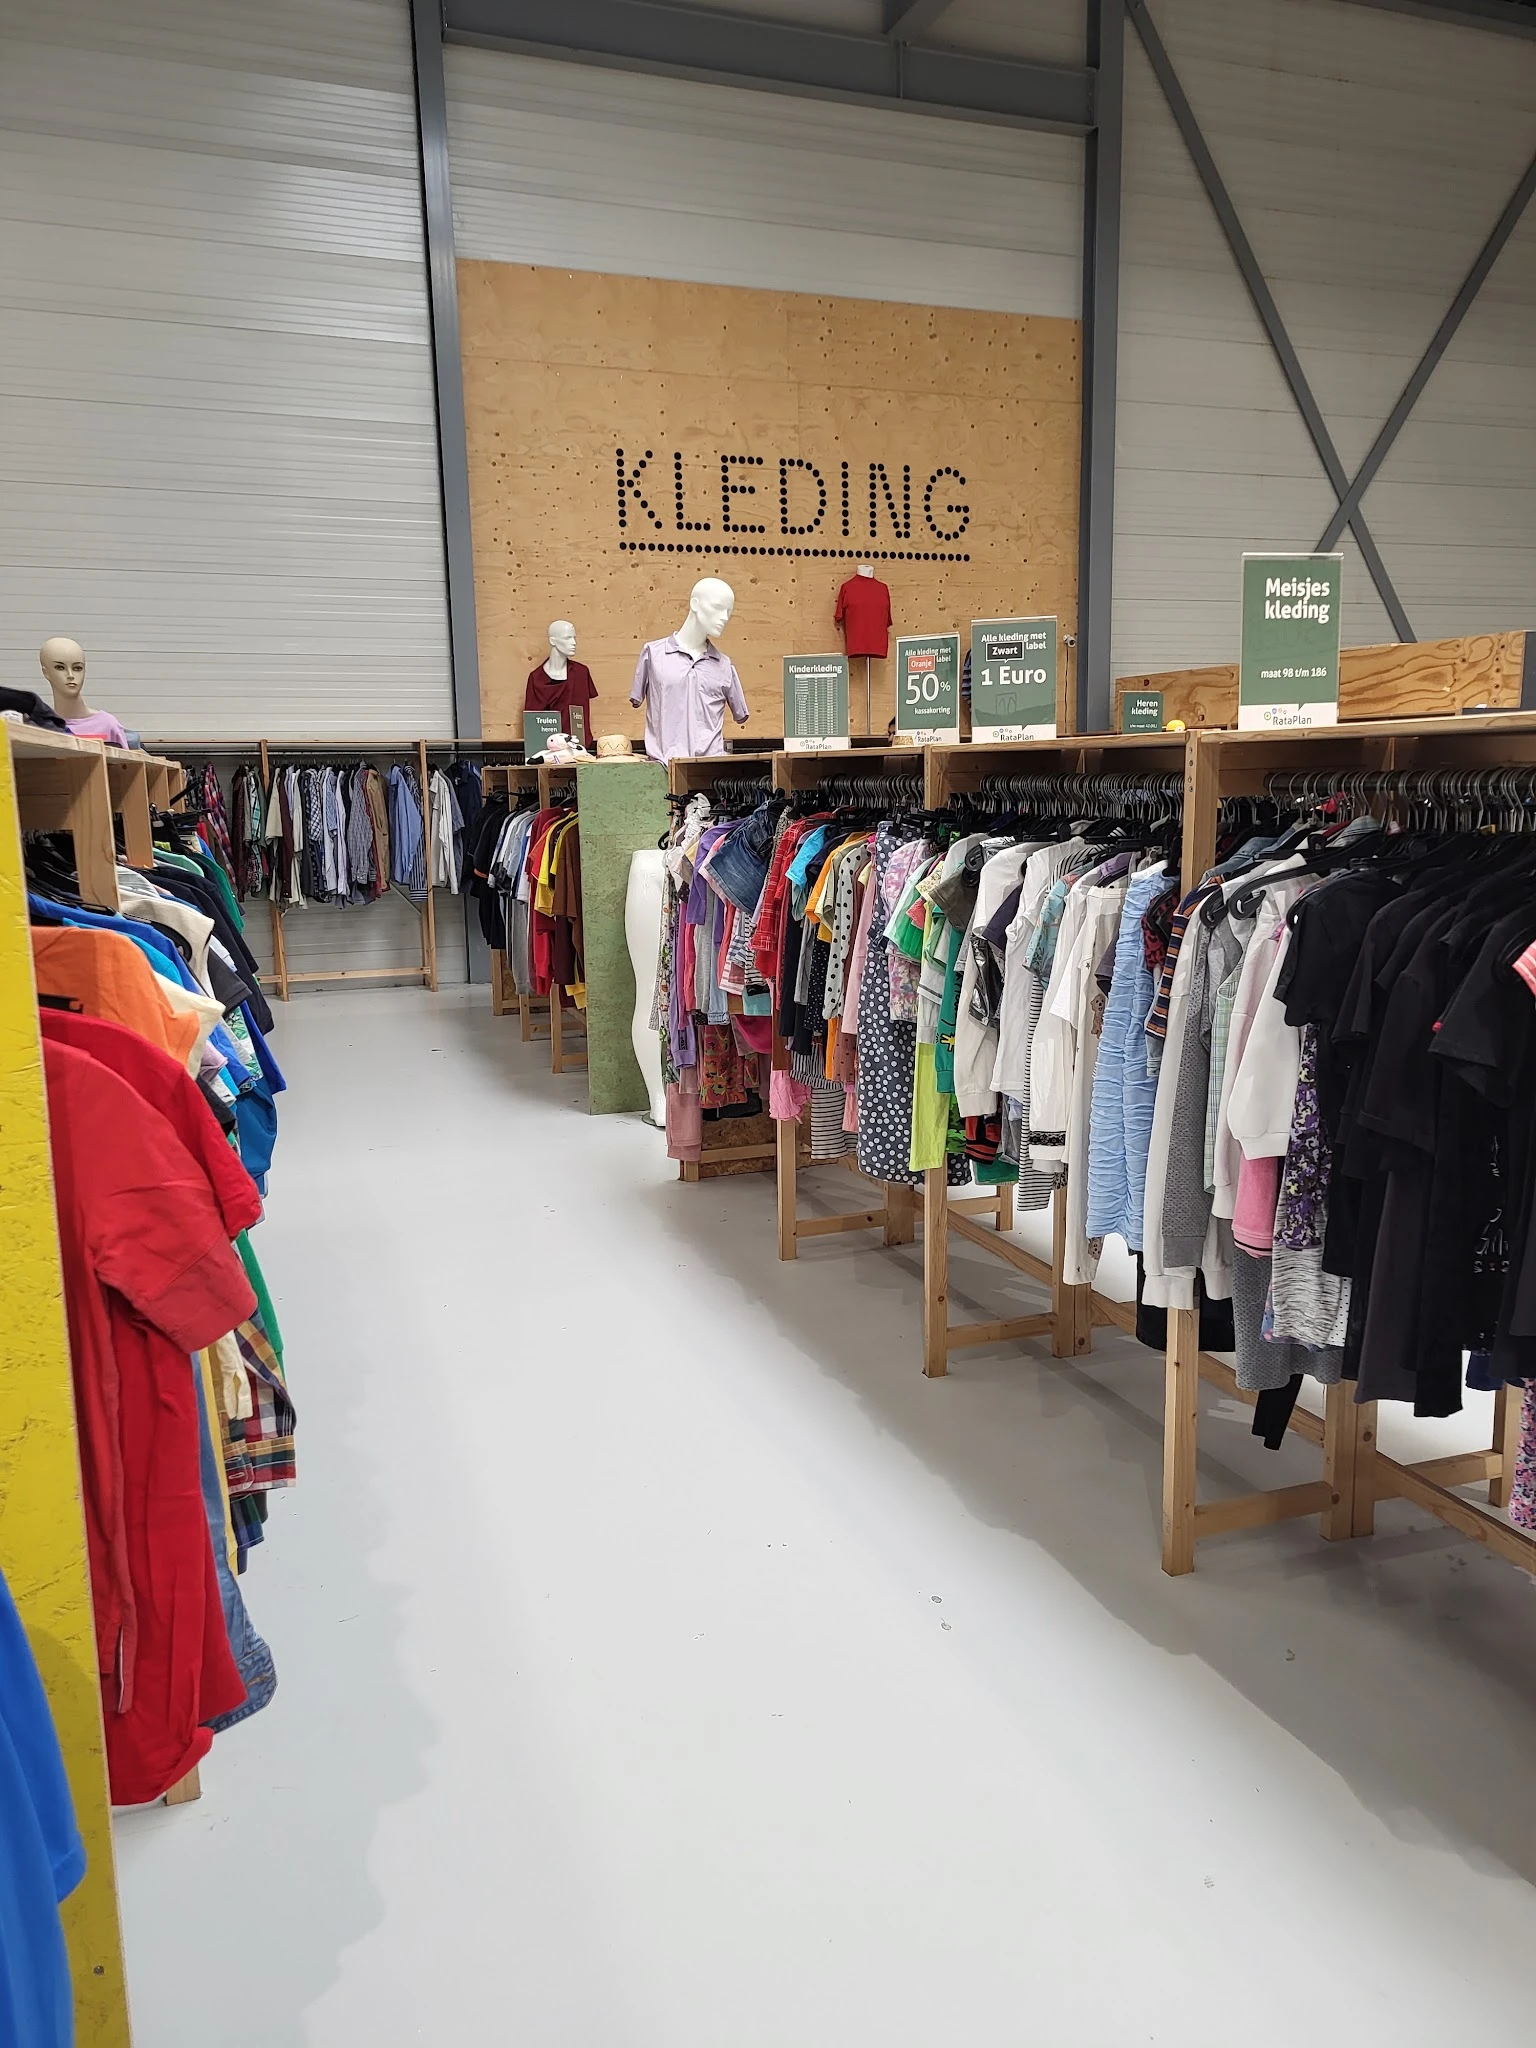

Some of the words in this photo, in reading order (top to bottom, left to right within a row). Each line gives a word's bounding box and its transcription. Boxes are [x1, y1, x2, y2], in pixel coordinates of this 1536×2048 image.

[616, 448, 970, 541] KLEDING
[1265, 577, 1330, 600] Meisjes
[1264, 600, 1330, 624] kleding
[981, 634, 997, 642] Alle
[998, 632, 1029, 642] kleding
[1030, 632, 1047, 640] met
[1026, 641, 1047, 650] label
[904, 649, 916, 657] Alle
[992, 646, 1018, 656] Zwart
[910, 660, 932, 668] Oranje
[936, 655, 951, 663] label
[788, 664, 842, 674] Kinderkleding
[1261, 669, 1281, 678] maat
[1282, 668, 1293, 678] 98
[1294, 668, 1309, 678] t/m
[1311, 667, 1327, 677] 186
[981, 668, 993, 686] 1
[999, 666, 1047, 685] Euro
[914, 706, 951, 715] kassakorting
[1131, 707, 1158, 717] kleding
[1272, 715, 1312, 726] RataPlan
